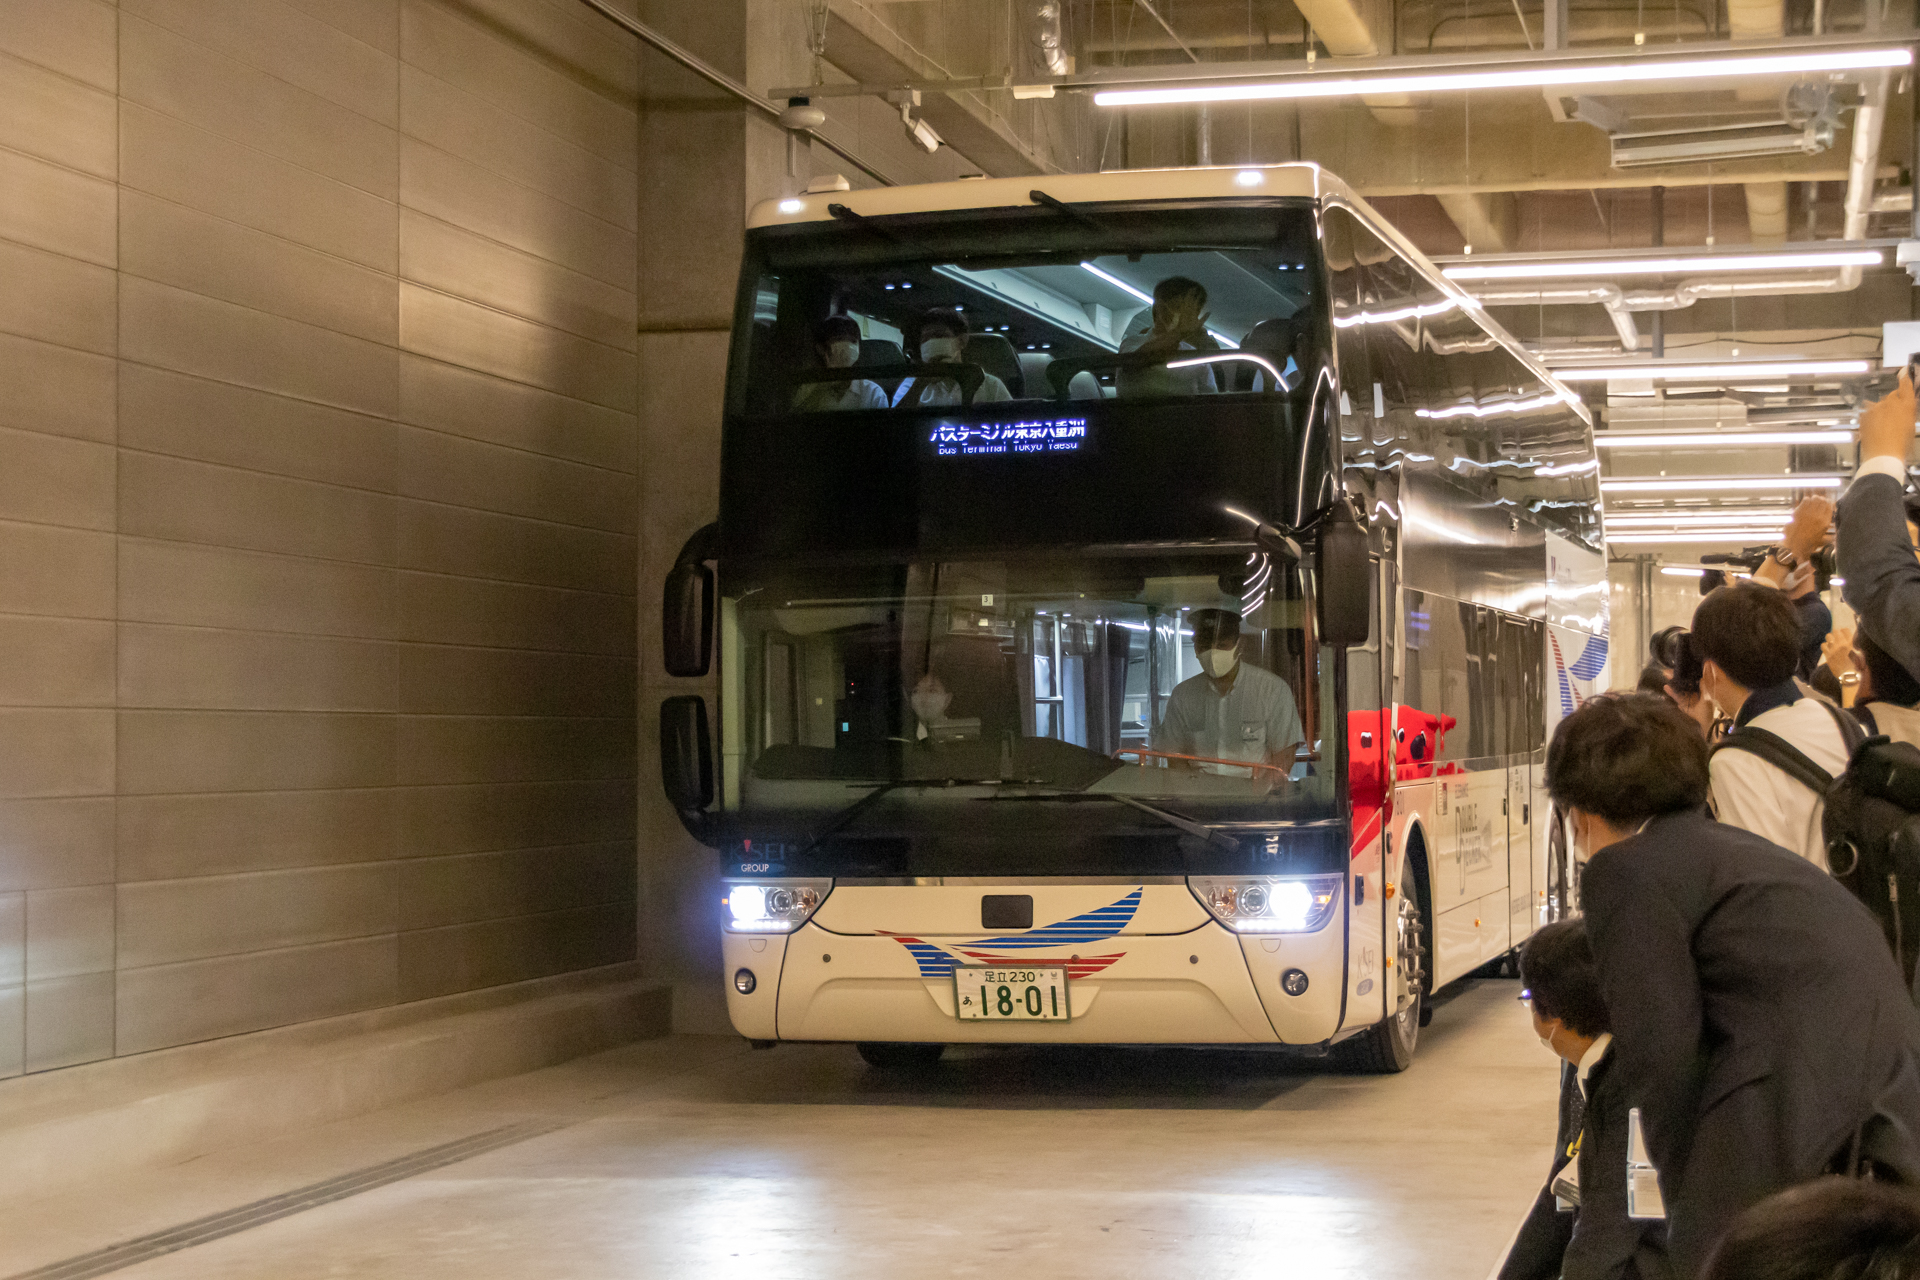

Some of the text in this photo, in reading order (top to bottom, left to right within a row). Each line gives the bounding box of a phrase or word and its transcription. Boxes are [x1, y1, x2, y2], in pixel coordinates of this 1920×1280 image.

[939, 439, 1078, 455] Bus Terminal Tokyo Yaesu
[741, 863, 770, 873] GROUP
[962, 995, 973, 1006] あ
[980, 985, 1058, 1017] 18-01
